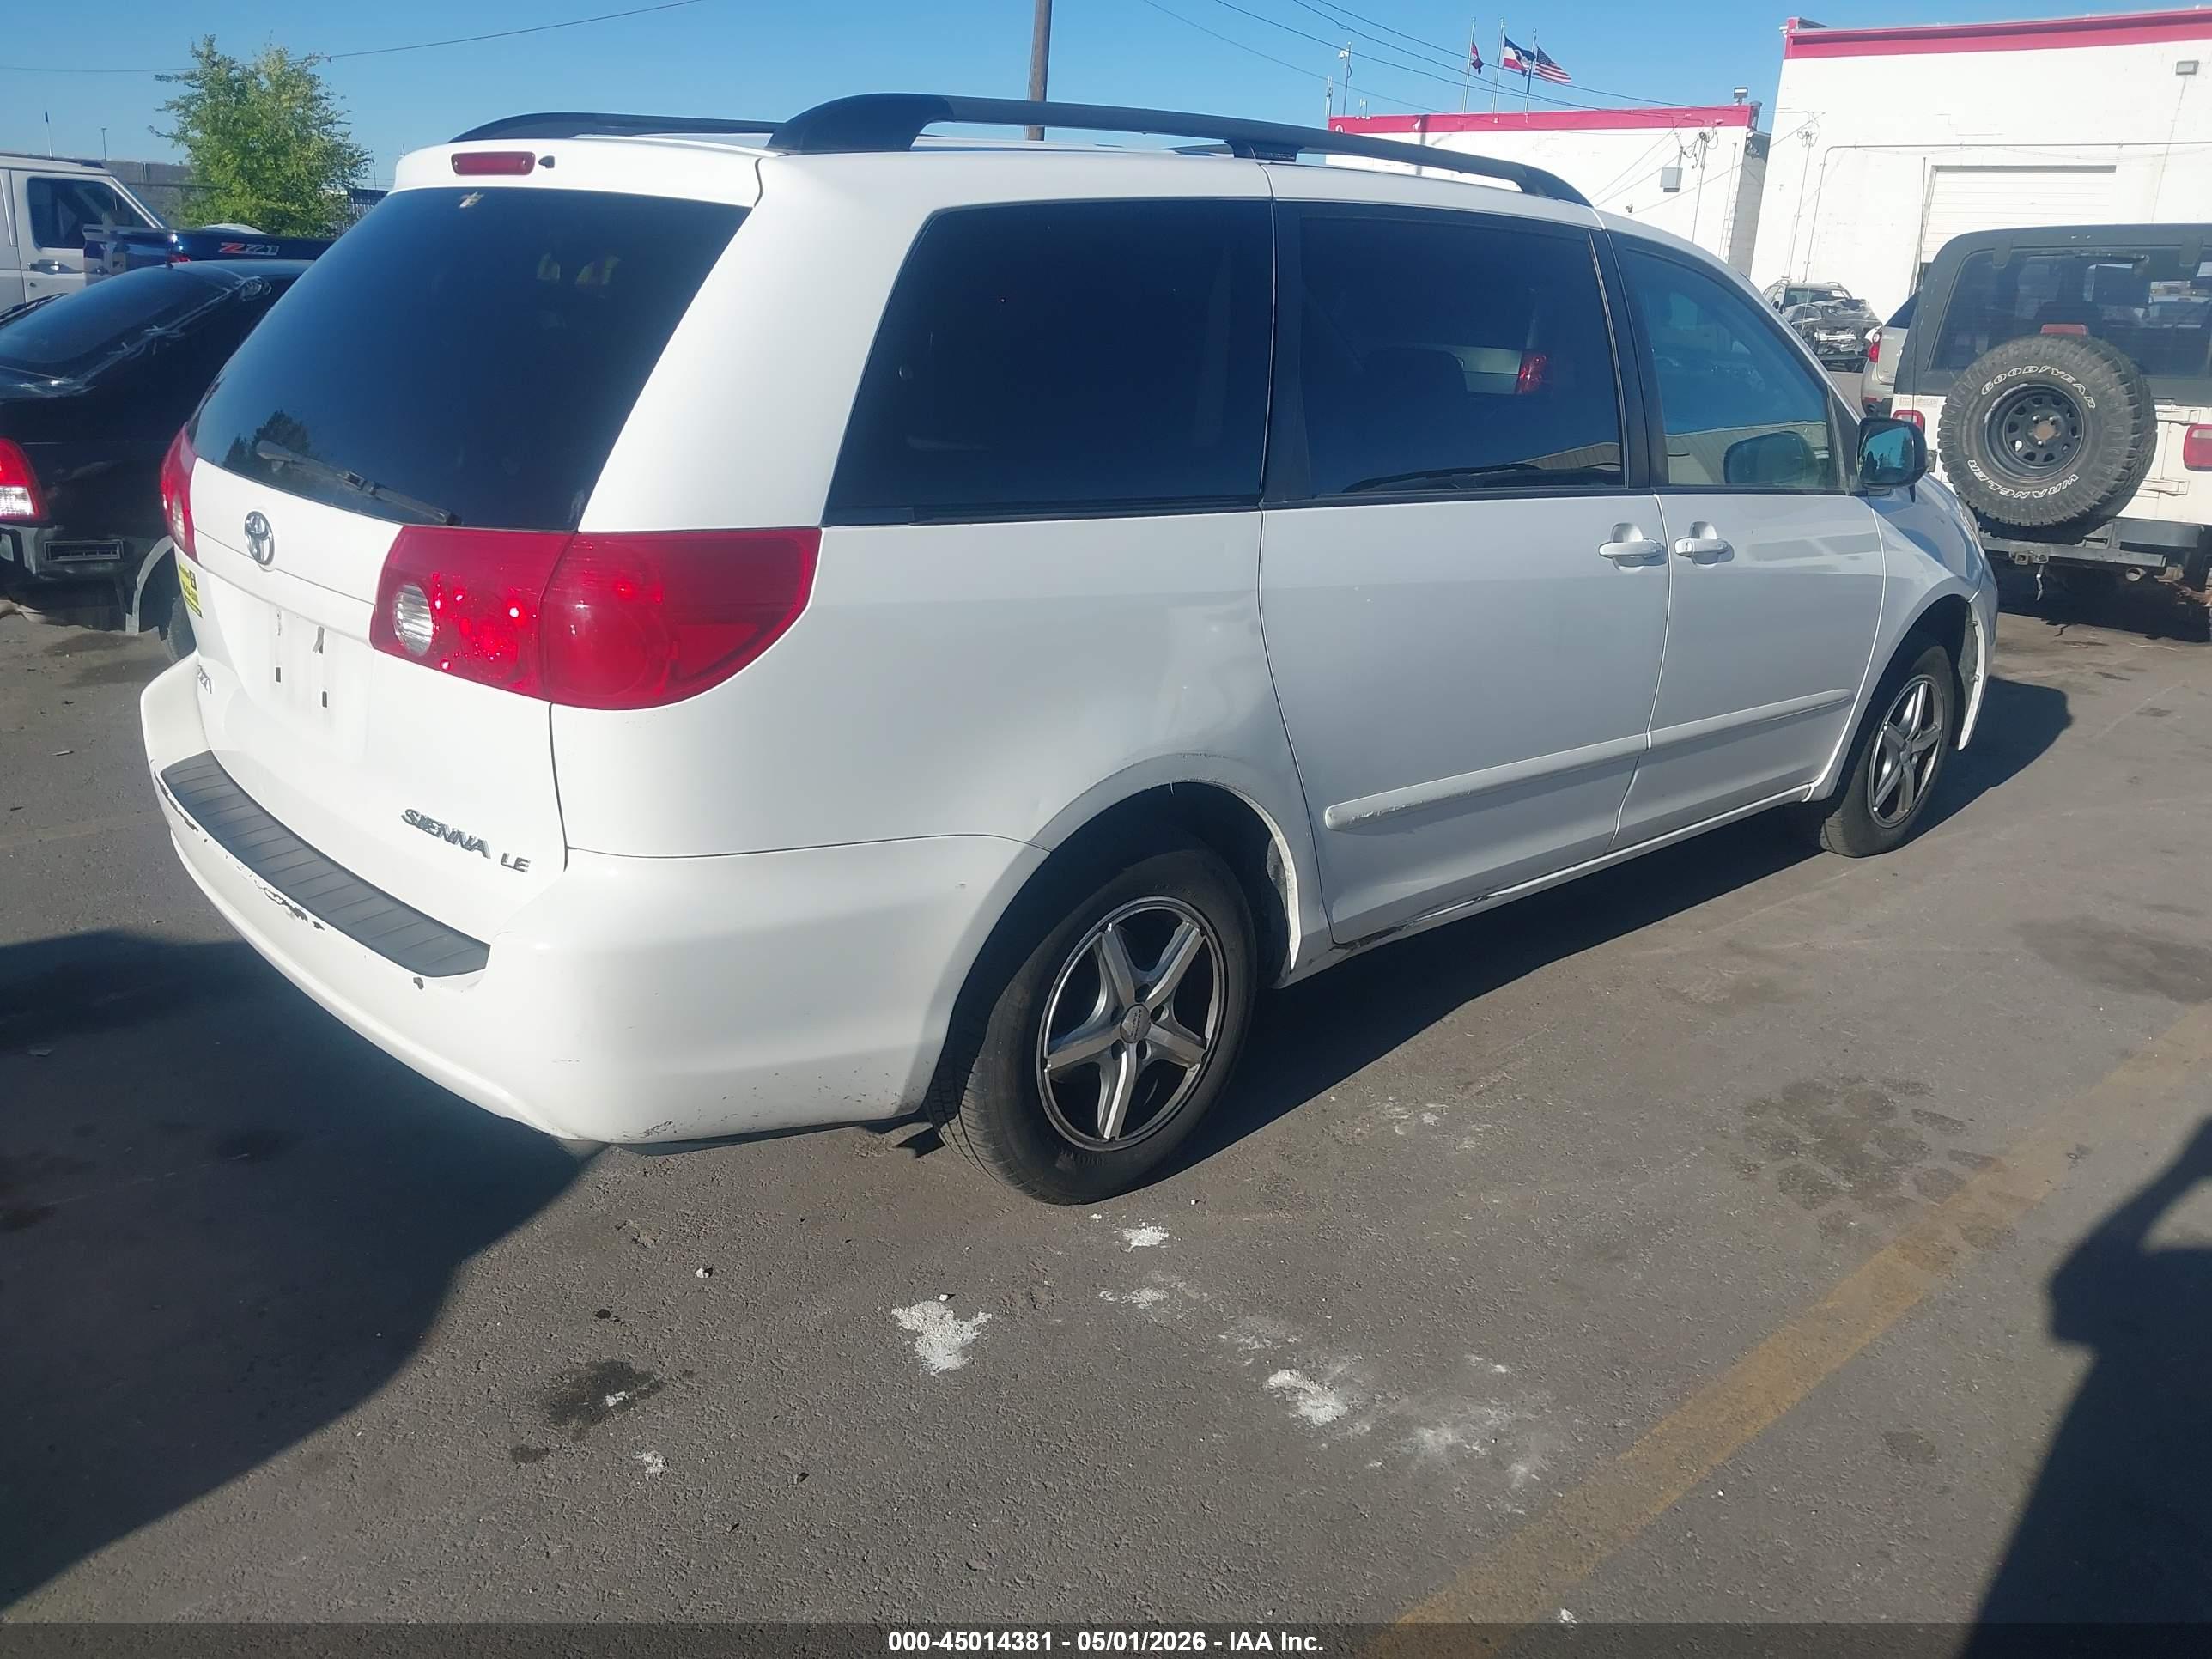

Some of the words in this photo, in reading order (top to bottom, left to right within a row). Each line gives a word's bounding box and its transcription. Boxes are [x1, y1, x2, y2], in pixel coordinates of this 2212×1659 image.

[217, 241, 280, 256] Z71
[1981, 365, 2096, 410] GOODYEAR
[1967, 459, 2080, 499] WRANGLER
[400, 808, 492, 860] SIENNA
[500, 852, 531, 873] LE
